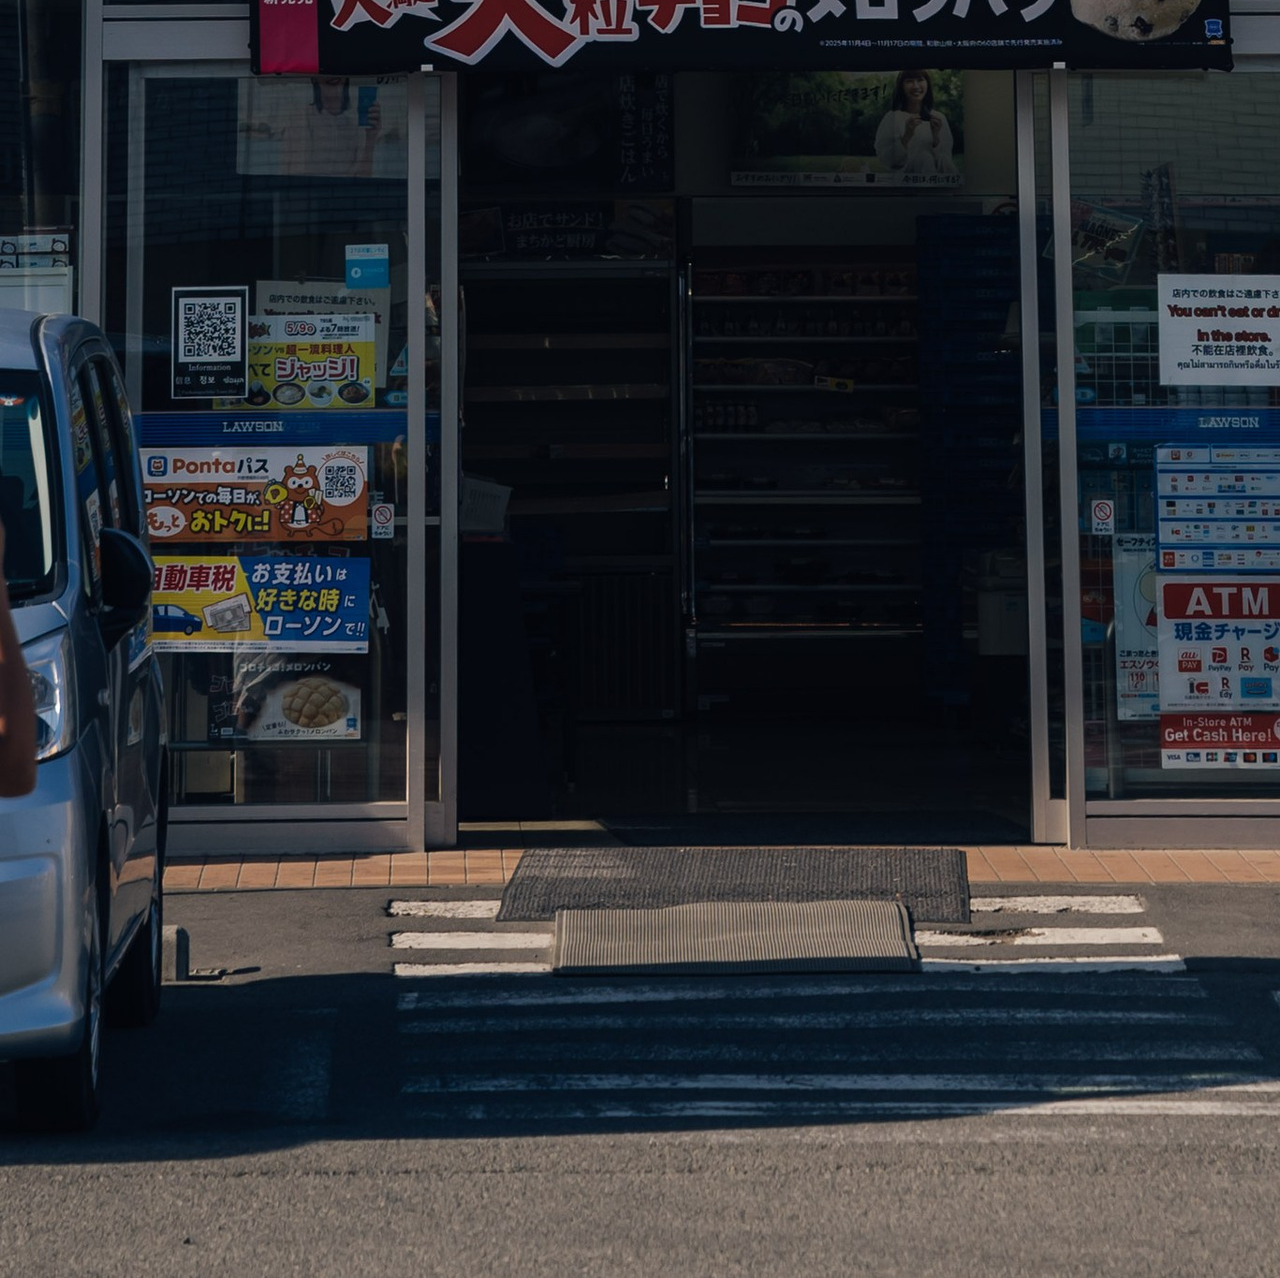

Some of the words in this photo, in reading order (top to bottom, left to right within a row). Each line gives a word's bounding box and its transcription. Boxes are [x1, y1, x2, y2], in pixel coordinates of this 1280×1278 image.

[1168, 305, 1192, 317] You
[1194, 305, 1227, 317] can't
[1228, 306, 1250, 318] eat
[1251, 308, 1265, 318] or
[1211, 329, 1233, 342] the
[1235, 330, 1272, 342] store.
[285, 344, 356, 355] 超一流料理人
[276, 357, 357, 380] ジャッジ!
[200, 375, 216, 385] 정보
[222, 421, 284, 433] LAWSON
[1198, 417, 1260, 428] LAWSON
[149, 511, 181, 532] もっと
[153, 564, 236, 592] 自動車税
[252, 563, 347, 584] お支払いは
[256, 589, 355, 612] 好きな時に
[1185, 587, 1269, 615] ATM
[1174, 622, 1280, 641] 現金チャージ
[1181, 651, 1198, 659] au
[1182, 661, 1198, 669] PAY
[1238, 664, 1255, 672] Pay
[1263, 663, 1280, 673] Pay
[1130, 672, 1145, 681] 110
[1219, 691, 1233, 699] Edy
[1183, 717, 1227, 727] In-Store
[1229, 717, 1252, 727] ATM
[1164, 728, 1189, 741] Get
[1193, 728, 1227, 742] Cash
[1232, 728, 1272, 742] Here!
